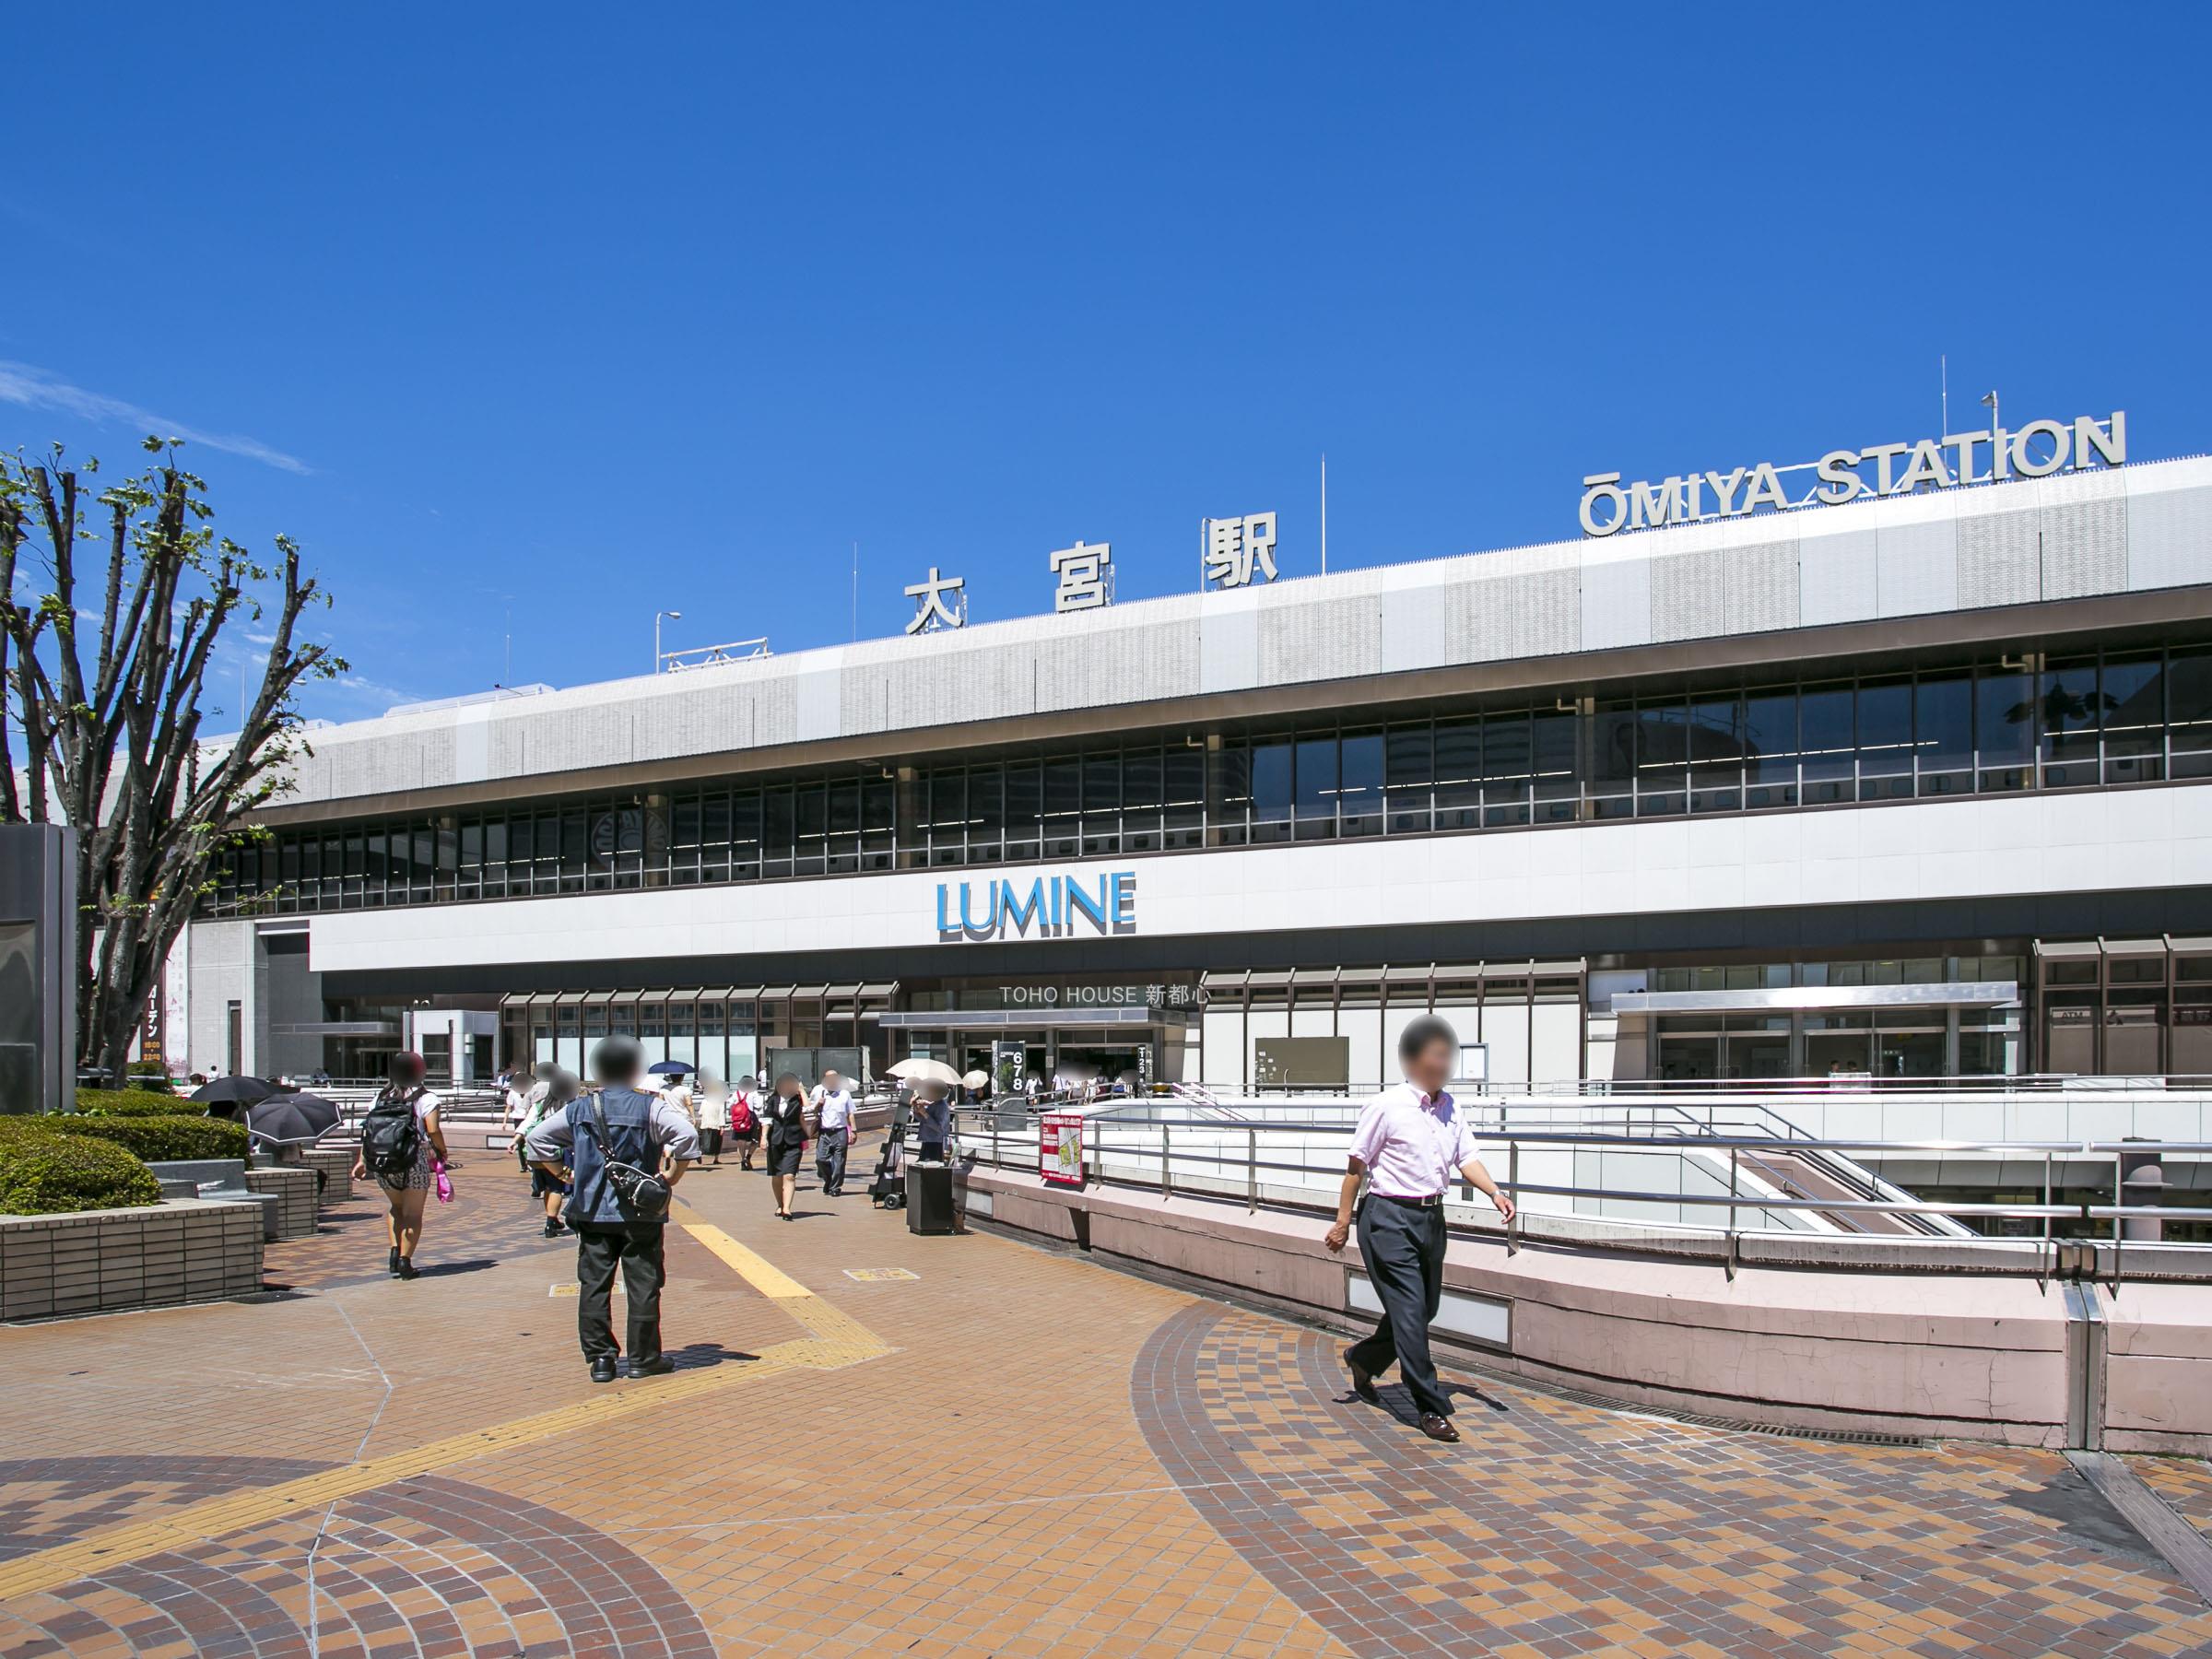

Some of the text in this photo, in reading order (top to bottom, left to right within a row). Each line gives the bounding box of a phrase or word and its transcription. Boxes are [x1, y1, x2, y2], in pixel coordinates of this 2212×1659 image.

[1579, 410, 2126, 538] ŌMIYA STATION
[904, 511, 1279, 635] 大宮駅
[936, 871, 1136, 934] LUMINE
